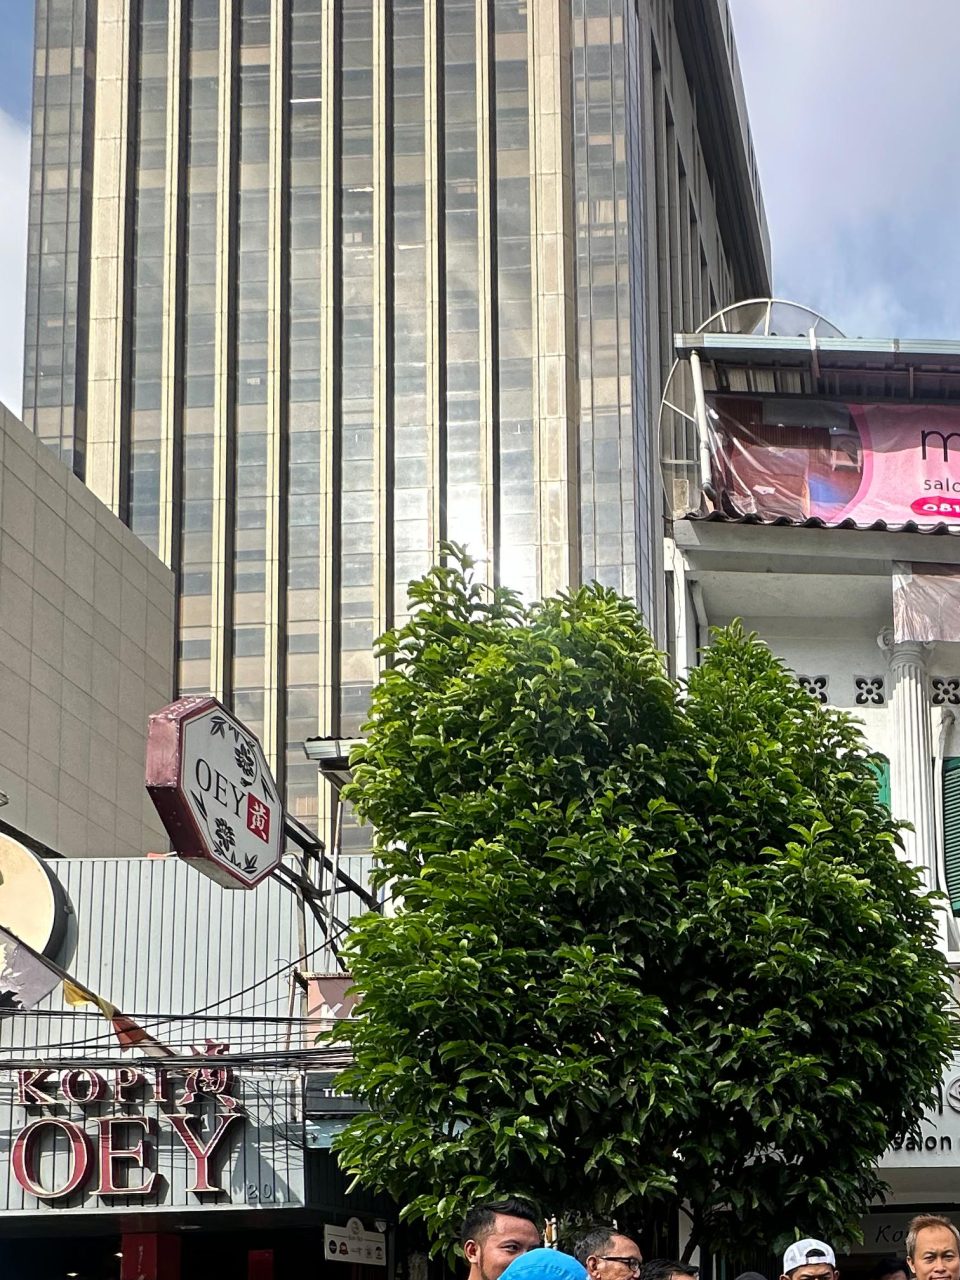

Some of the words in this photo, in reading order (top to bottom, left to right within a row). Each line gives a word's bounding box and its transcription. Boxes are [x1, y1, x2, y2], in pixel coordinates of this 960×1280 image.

[195, 758, 247, 819] OEY
[14, 1067, 167, 1105] KOPI
[12, 1114, 241, 1199] OEY
[894, 1133, 952, 1150] salon
[247, 1183, 272, 1199] 20
